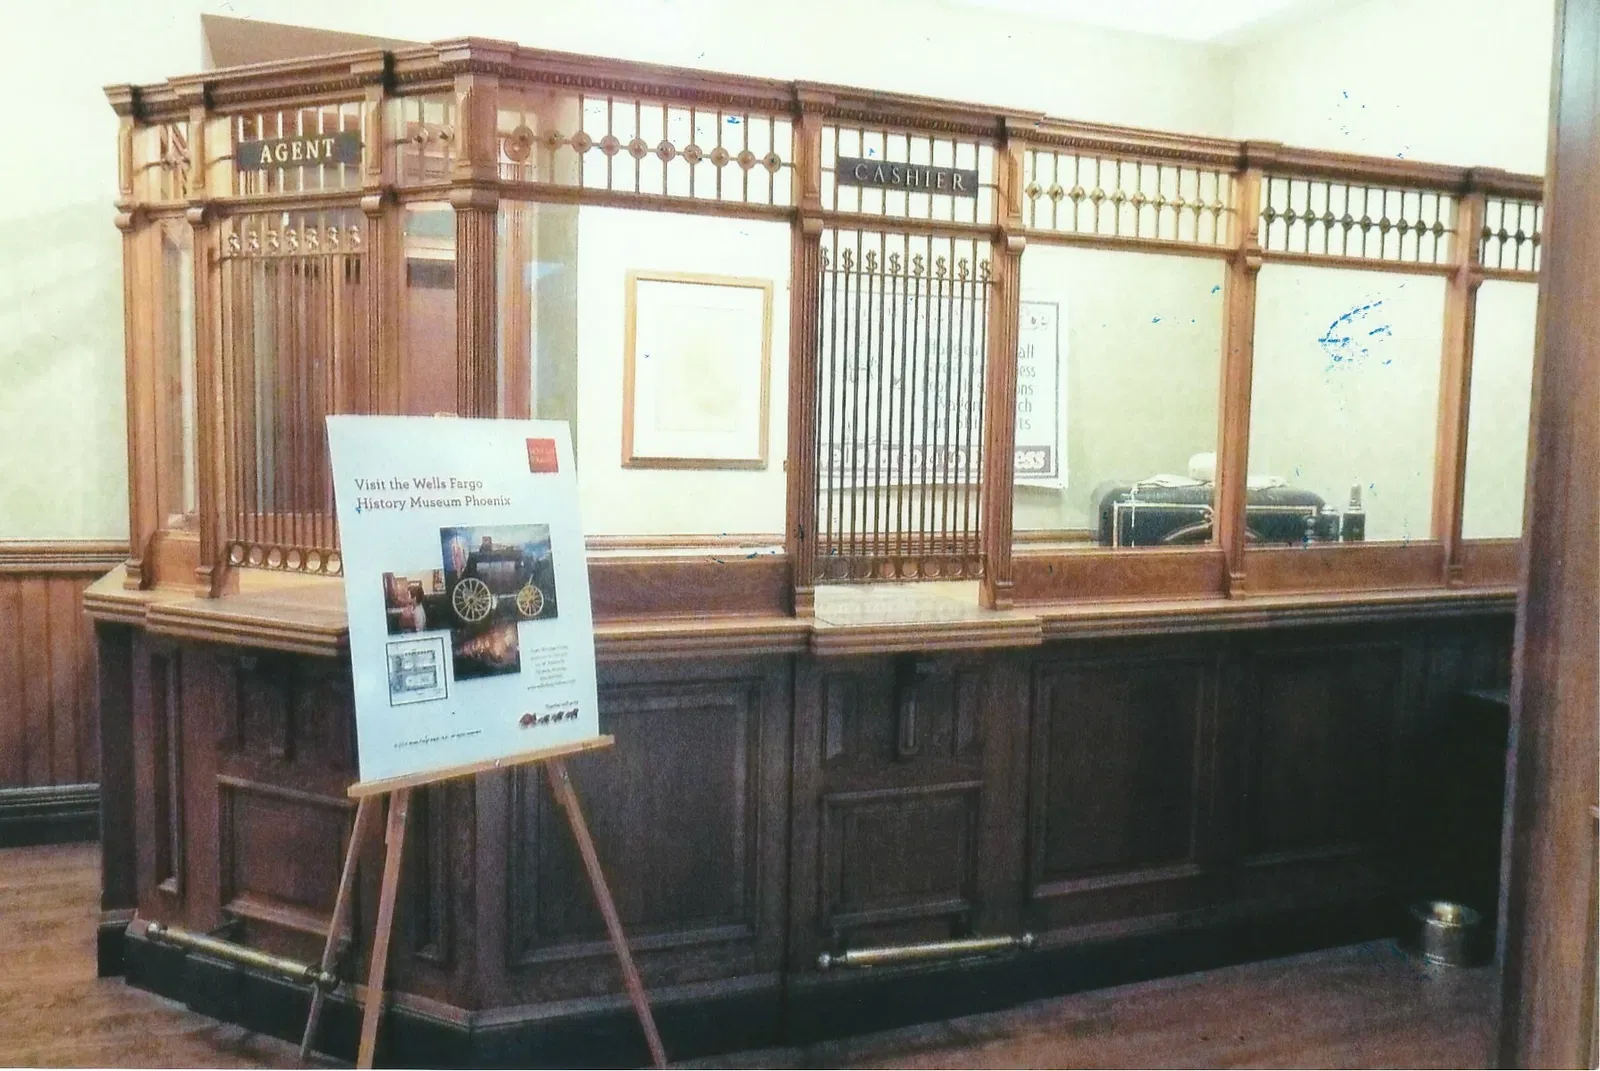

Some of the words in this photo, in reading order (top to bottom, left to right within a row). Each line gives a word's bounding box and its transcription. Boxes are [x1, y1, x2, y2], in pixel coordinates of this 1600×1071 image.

[260, 138, 335, 164] AGENT
[854, 163, 965, 191] CASHIER
[354, 478, 386, 490] Visit
[389, 476, 410, 490] the
[412, 476, 447, 490] Wells
[449, 477, 483, 492] Fargo
[357, 497, 406, 511] History
[410, 496, 462, 508] Museum
[465, 494, 511, 507] Phoenix
